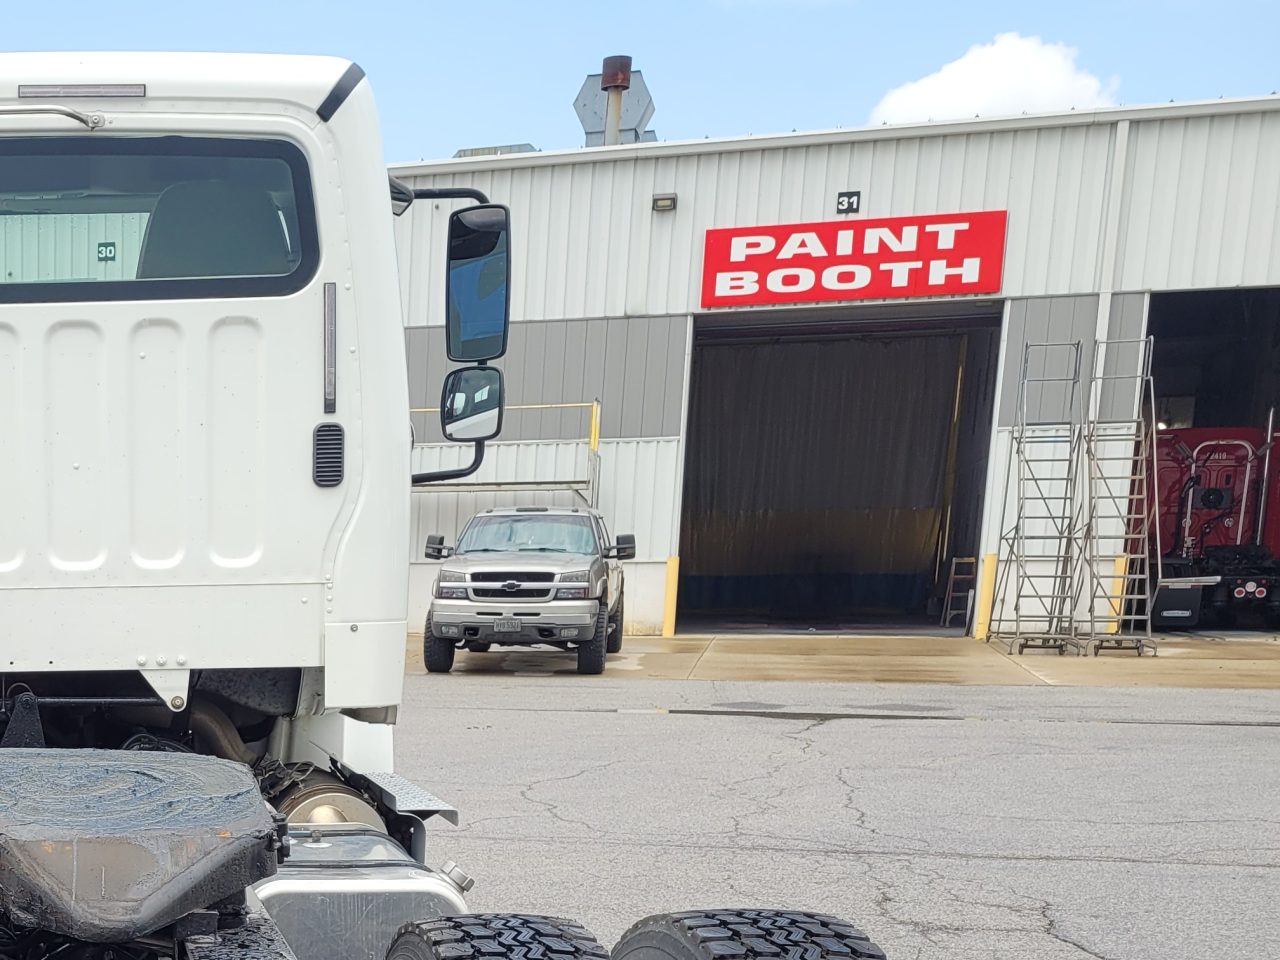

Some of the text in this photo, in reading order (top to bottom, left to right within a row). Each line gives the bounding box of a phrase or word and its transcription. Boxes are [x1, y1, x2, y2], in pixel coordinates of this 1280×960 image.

[838, 197, 858, 210] 31
[98, 246, 115, 258] 30
[730, 222, 970, 263] PAINT
[715, 257, 981, 297] BOOTH
